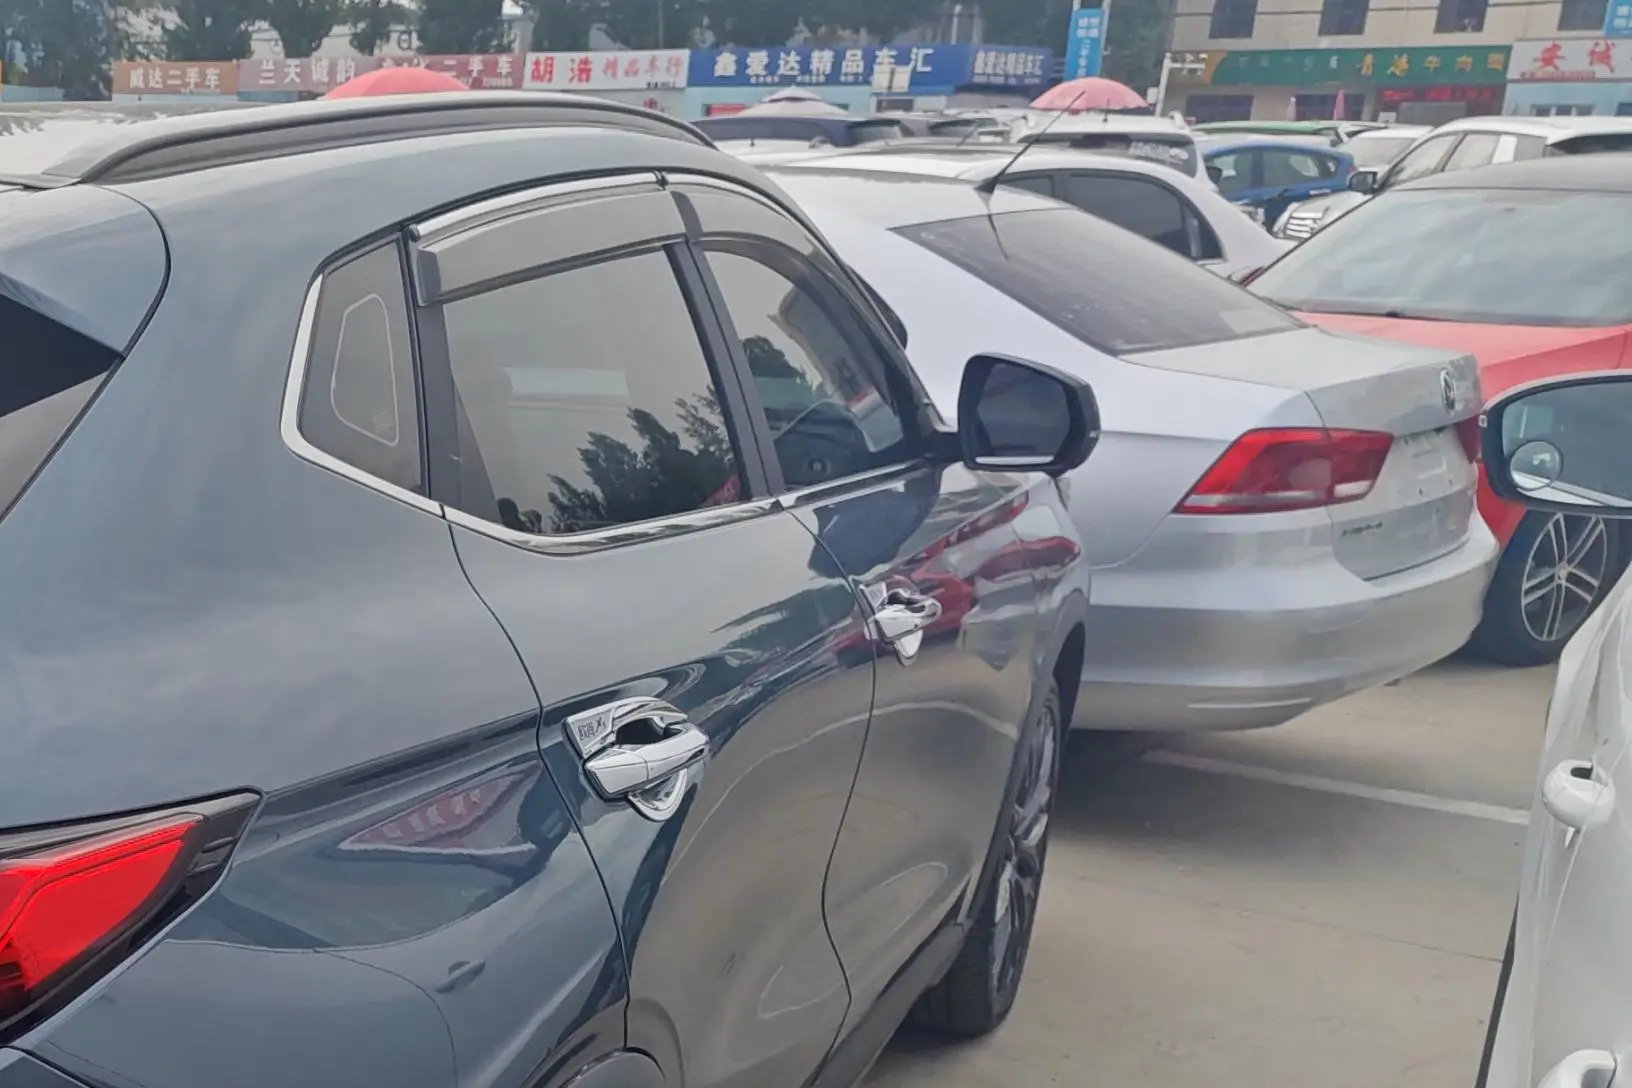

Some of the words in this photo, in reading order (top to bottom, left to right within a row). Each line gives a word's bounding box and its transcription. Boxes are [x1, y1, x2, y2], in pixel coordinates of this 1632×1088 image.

[714, 47, 935, 77] 鑫爱达精品车汇
